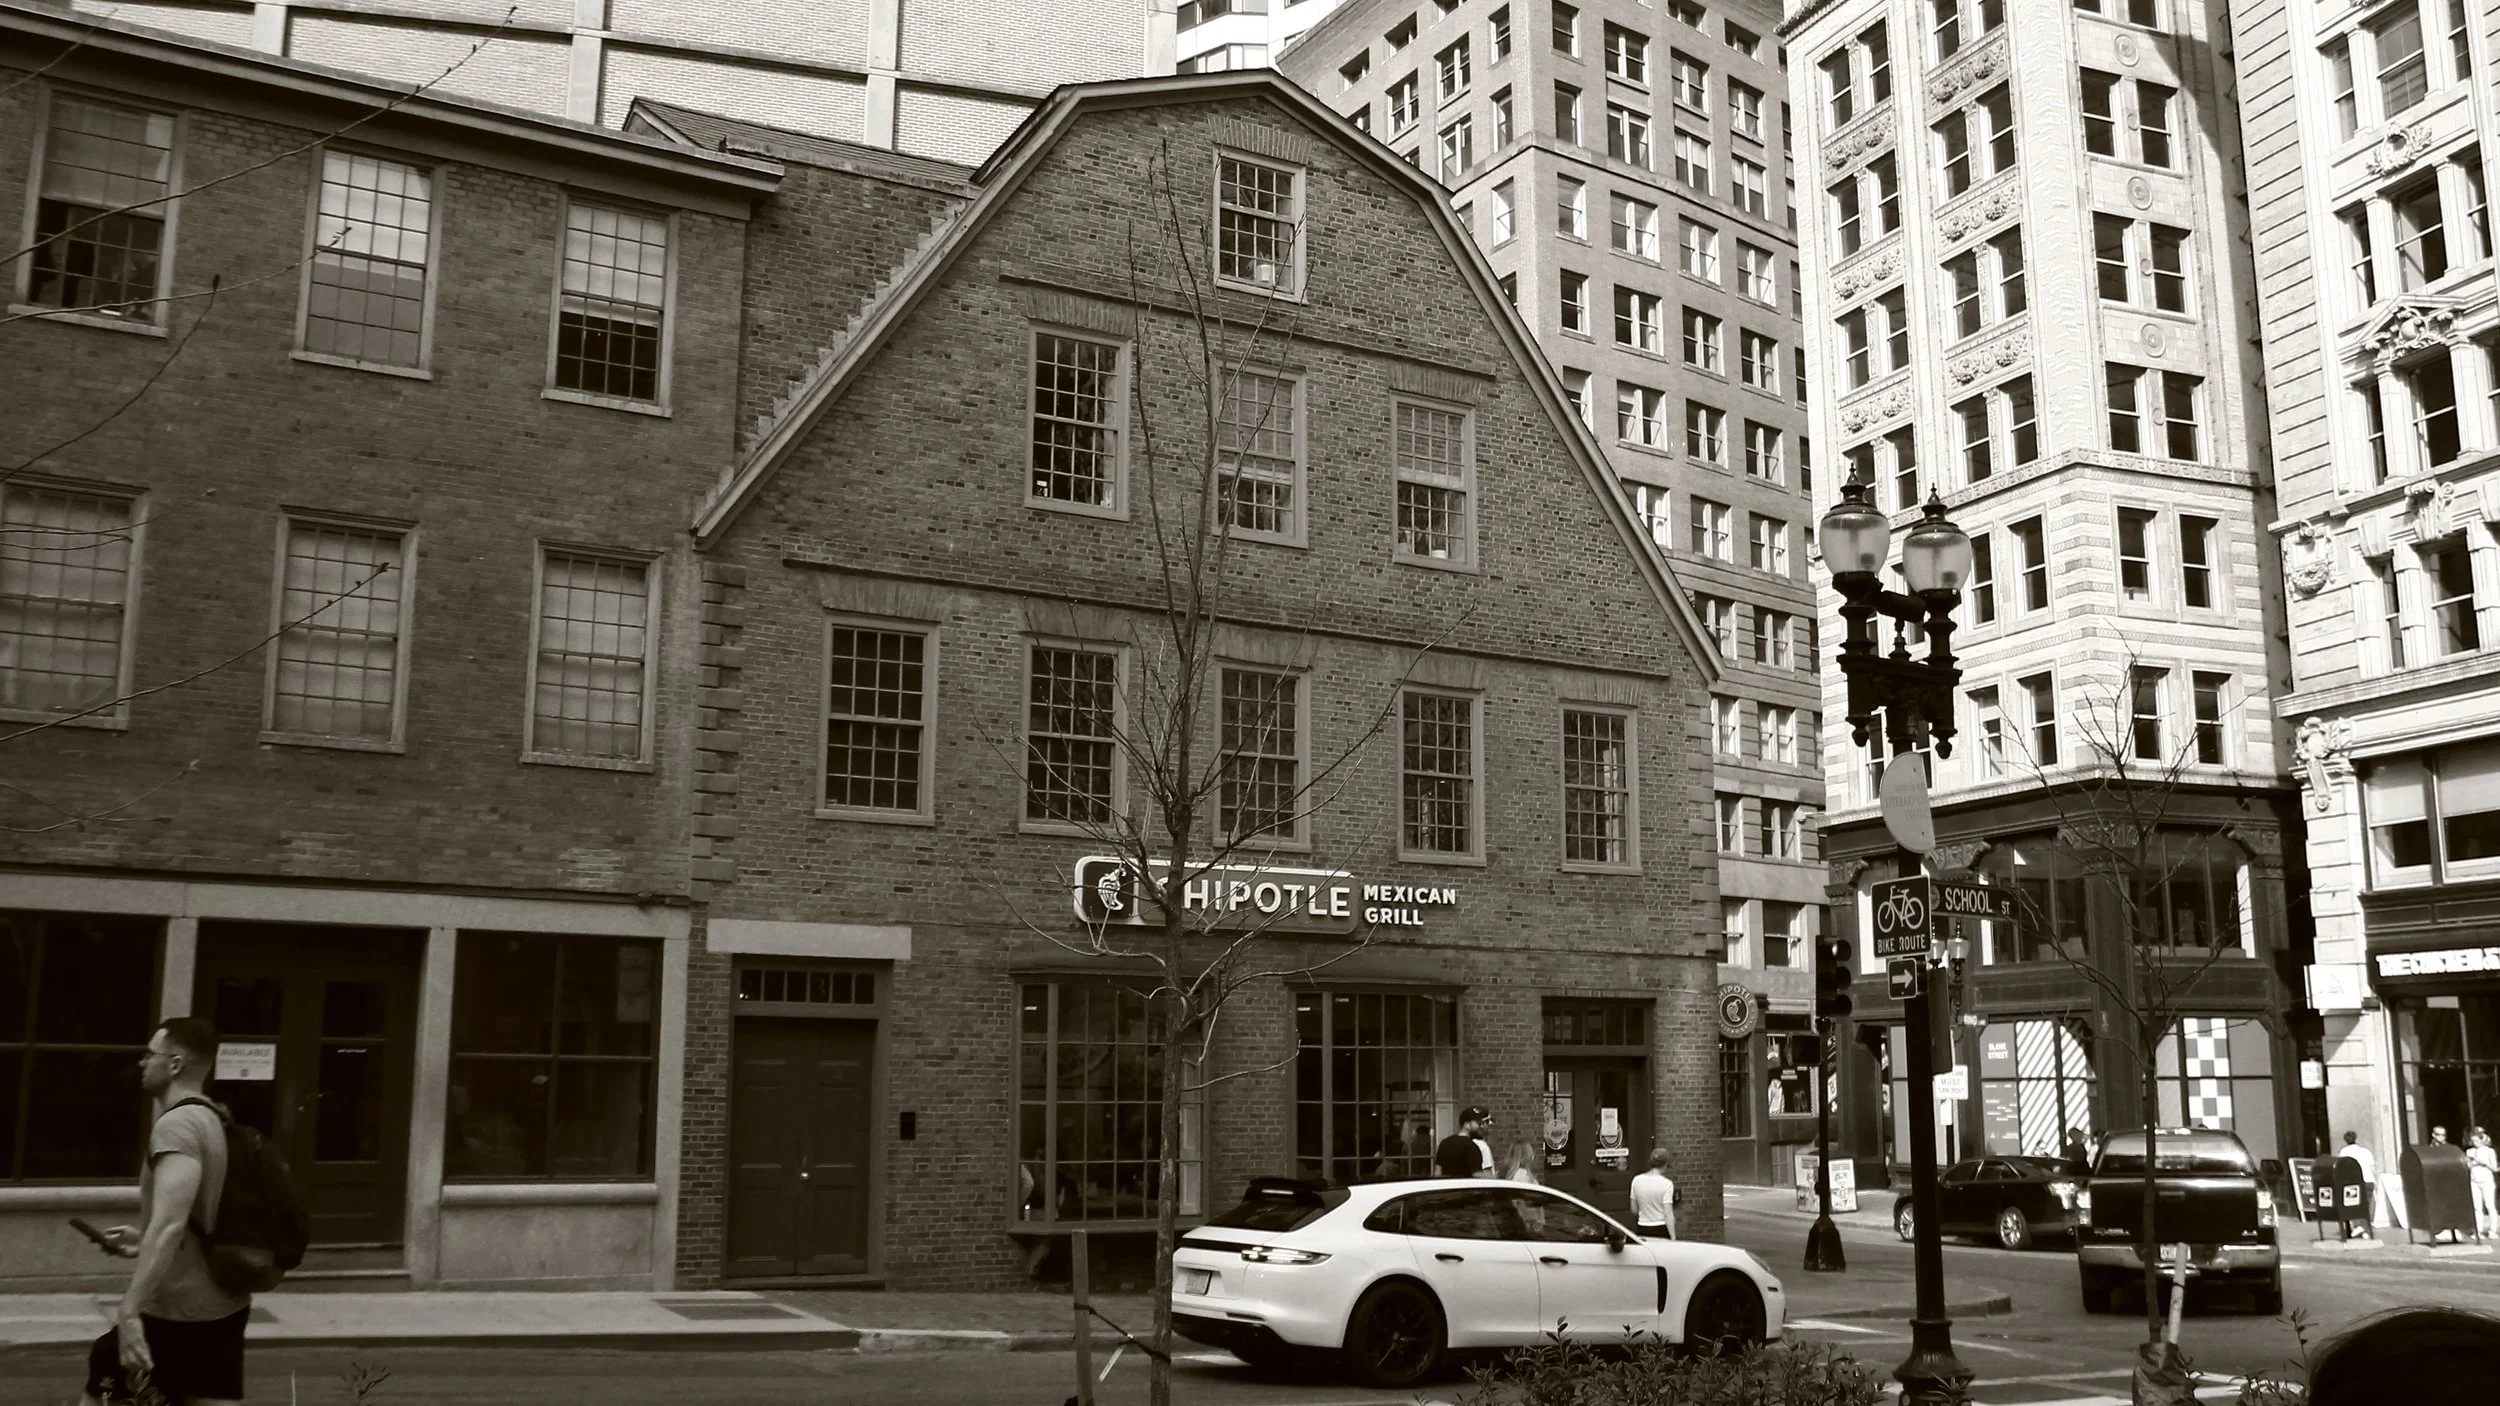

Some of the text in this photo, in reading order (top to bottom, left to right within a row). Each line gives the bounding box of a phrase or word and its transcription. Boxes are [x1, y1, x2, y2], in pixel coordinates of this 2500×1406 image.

[1157, 877, 1351, 917] HIPOTLE
[1363, 884, 1457, 905] MEXICAN
[1944, 887, 2010, 915] SCHOOL ST
[1364, 907, 1424, 926] GRILL
[1877, 933, 1926, 954] BIKE ROUTE
[1940, 1078, 1960, 1086] MUST
